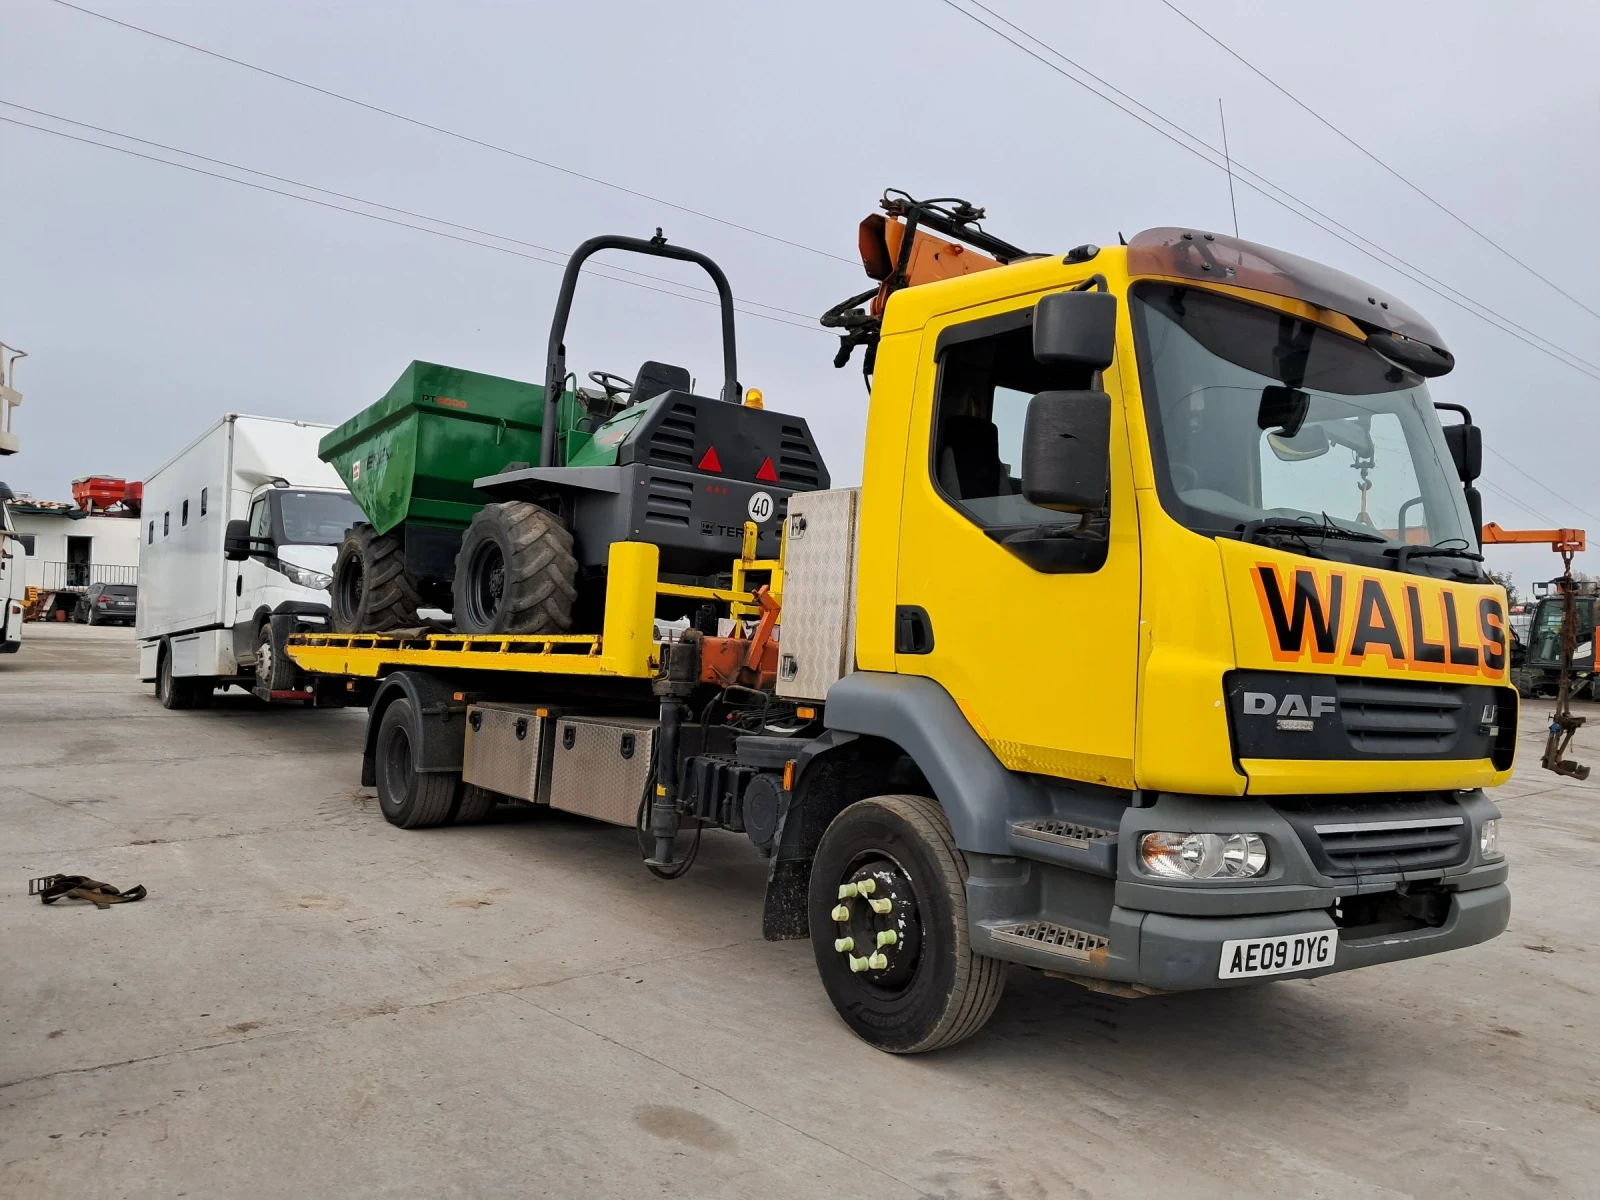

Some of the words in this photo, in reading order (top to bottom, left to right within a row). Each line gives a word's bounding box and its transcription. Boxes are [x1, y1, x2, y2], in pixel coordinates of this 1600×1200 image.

[752, 497, 769, 517] 40
[718, 524, 764, 541] TERX
[1250, 561, 1506, 680] WALLS
[1243, 692, 1336, 718] DAF
[1230, 941, 1288, 973] AE09
[1292, 935, 1329, 966] DYG
